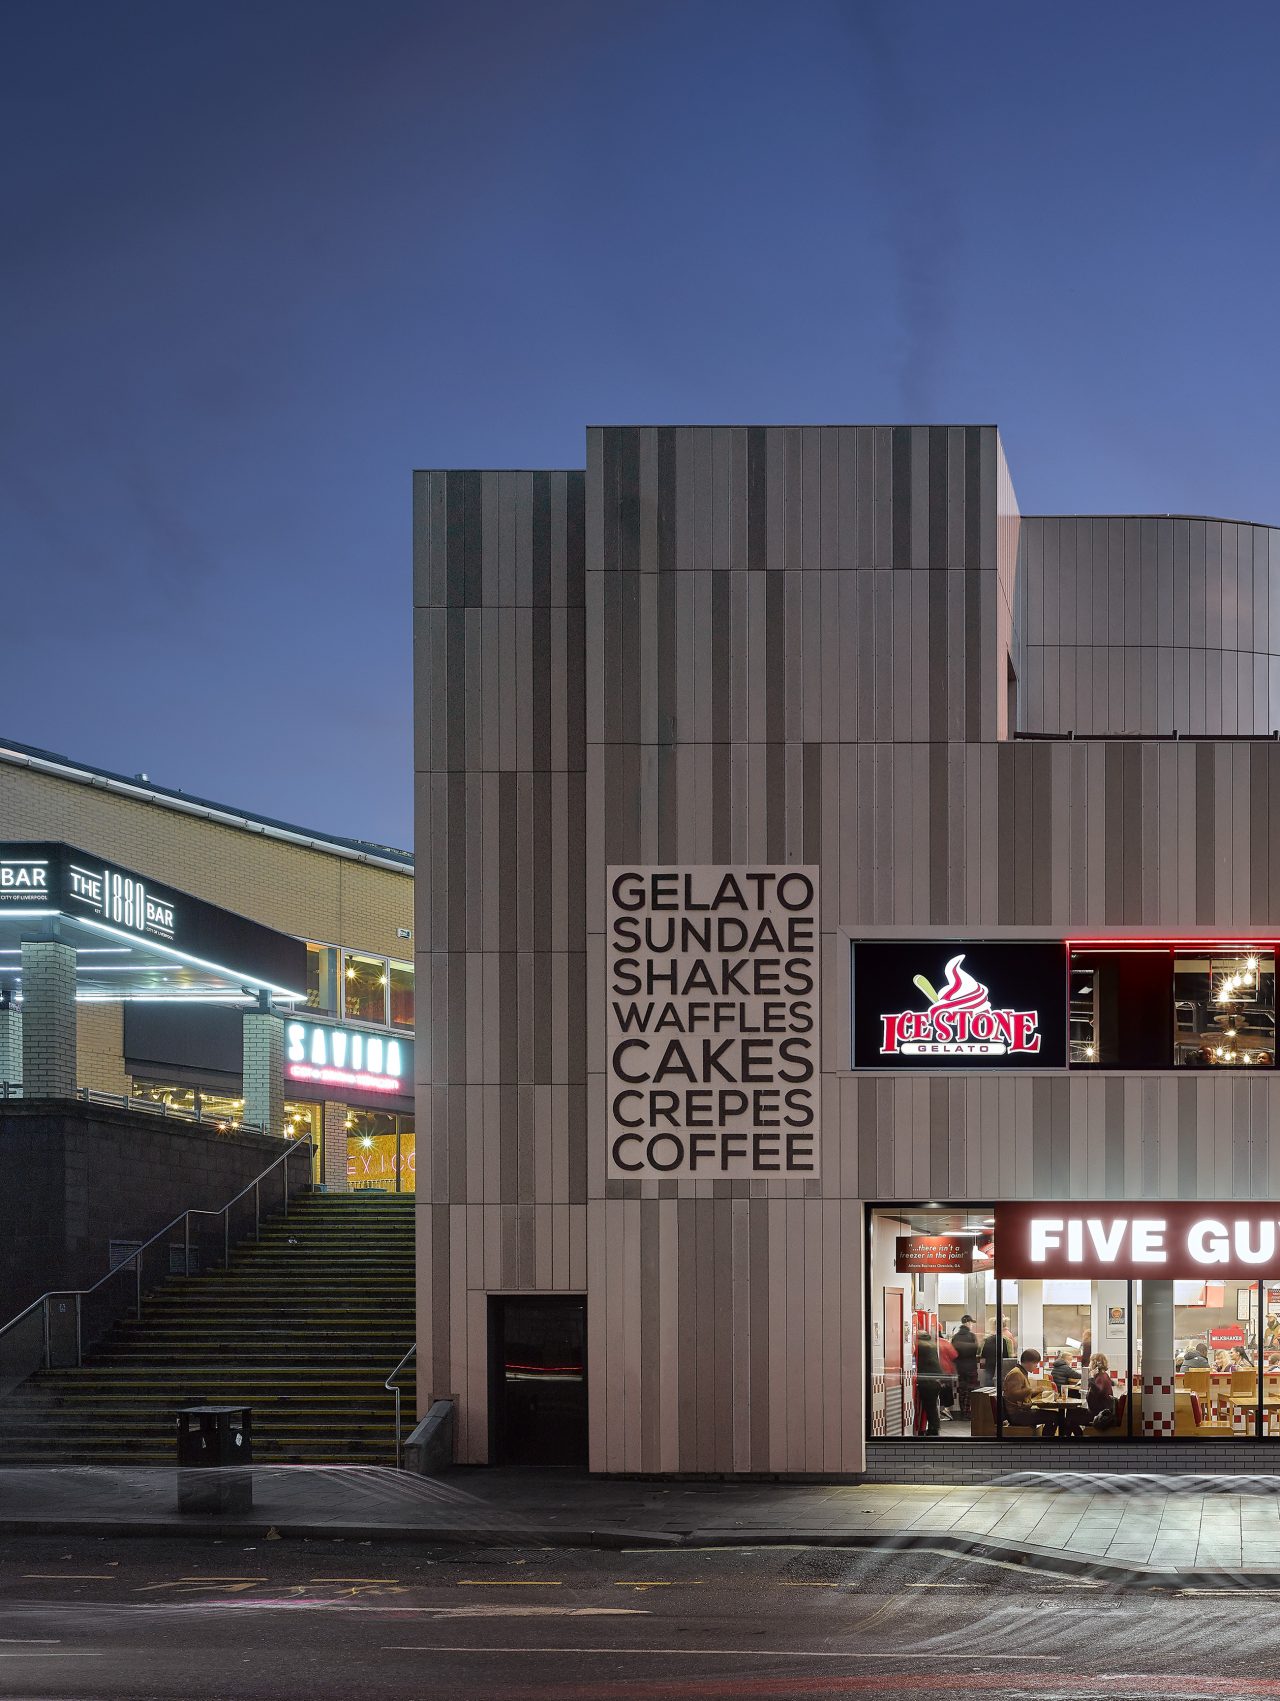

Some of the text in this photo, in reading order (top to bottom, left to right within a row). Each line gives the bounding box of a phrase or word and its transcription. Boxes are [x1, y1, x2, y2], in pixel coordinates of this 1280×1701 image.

[1, 868, 46, 887] BAR
[612, 873, 814, 911] GELATO
[70, 870, 173, 931] THE 1880 BAR
[612, 917, 814, 953] SUNDAE
[612, 958, 814, 996] SHAKES
[612, 1002, 814, 1033] WAFFLES
[288, 1024, 401, 1077] SAVINA
[612, 1038, 814, 1084] CAKES
[917, 1045, 989, 1053] GELATO
[612, 1089, 814, 1128] CREPES
[612, 1133, 814, 1172] COFFEE
[900, 1251, 925, 1259] freezer
[1030, 1219, 1167, 1263] FIVE
